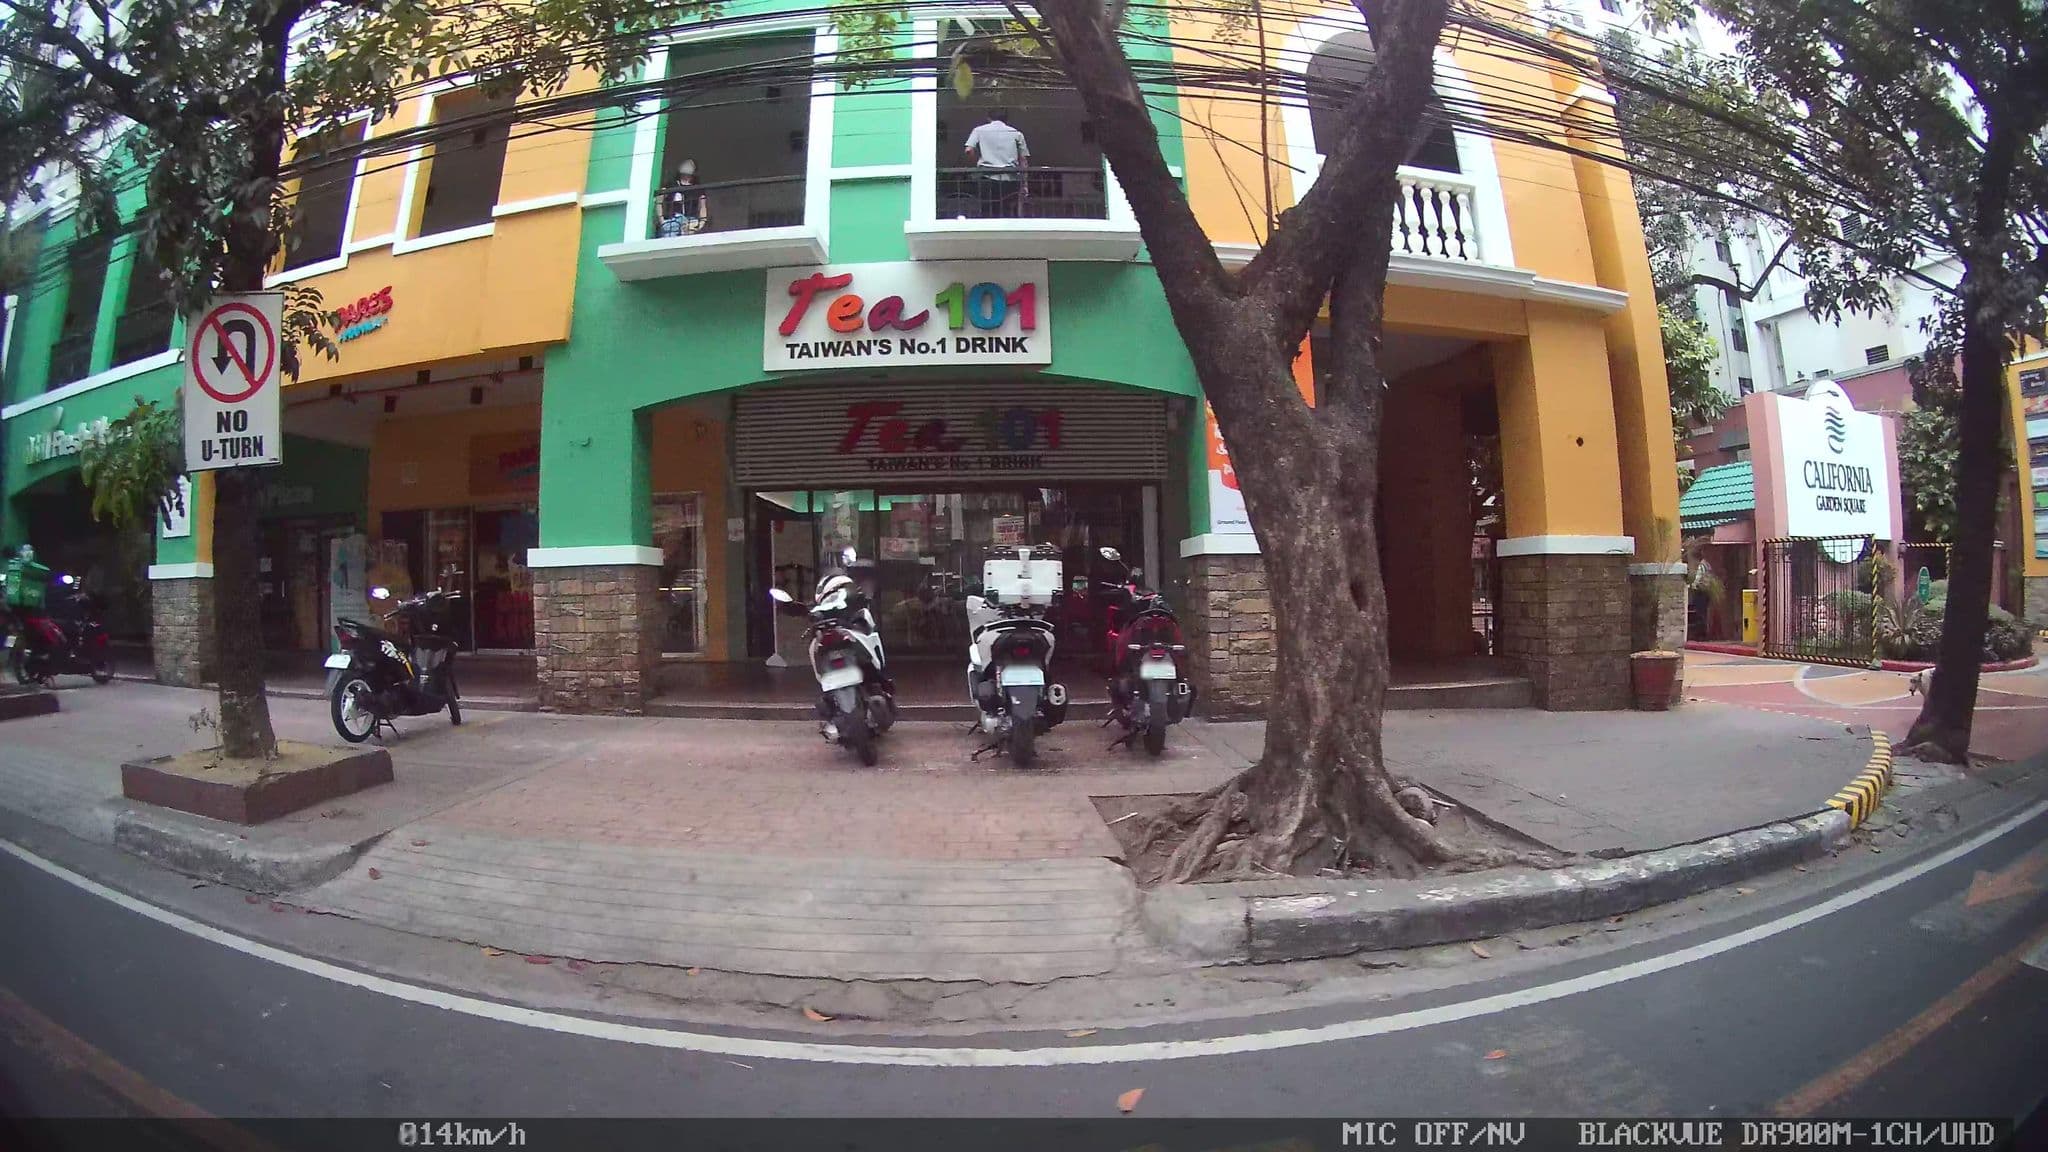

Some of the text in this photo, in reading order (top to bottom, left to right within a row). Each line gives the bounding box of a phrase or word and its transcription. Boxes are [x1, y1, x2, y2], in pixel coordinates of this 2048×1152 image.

[778, 272, 1036, 336] Tea 101
[785, 336, 1028, 359] TAIWAN'S No.1 DRINK
[216, 409, 248, 433] NO
[839, 400, 970, 454] Tea
[201, 435, 264, 461] U-TURN
[1803, 460, 1873, 494] CALIFORNIA
[1816, 495, 1867, 515] GARDEN SQUARE
